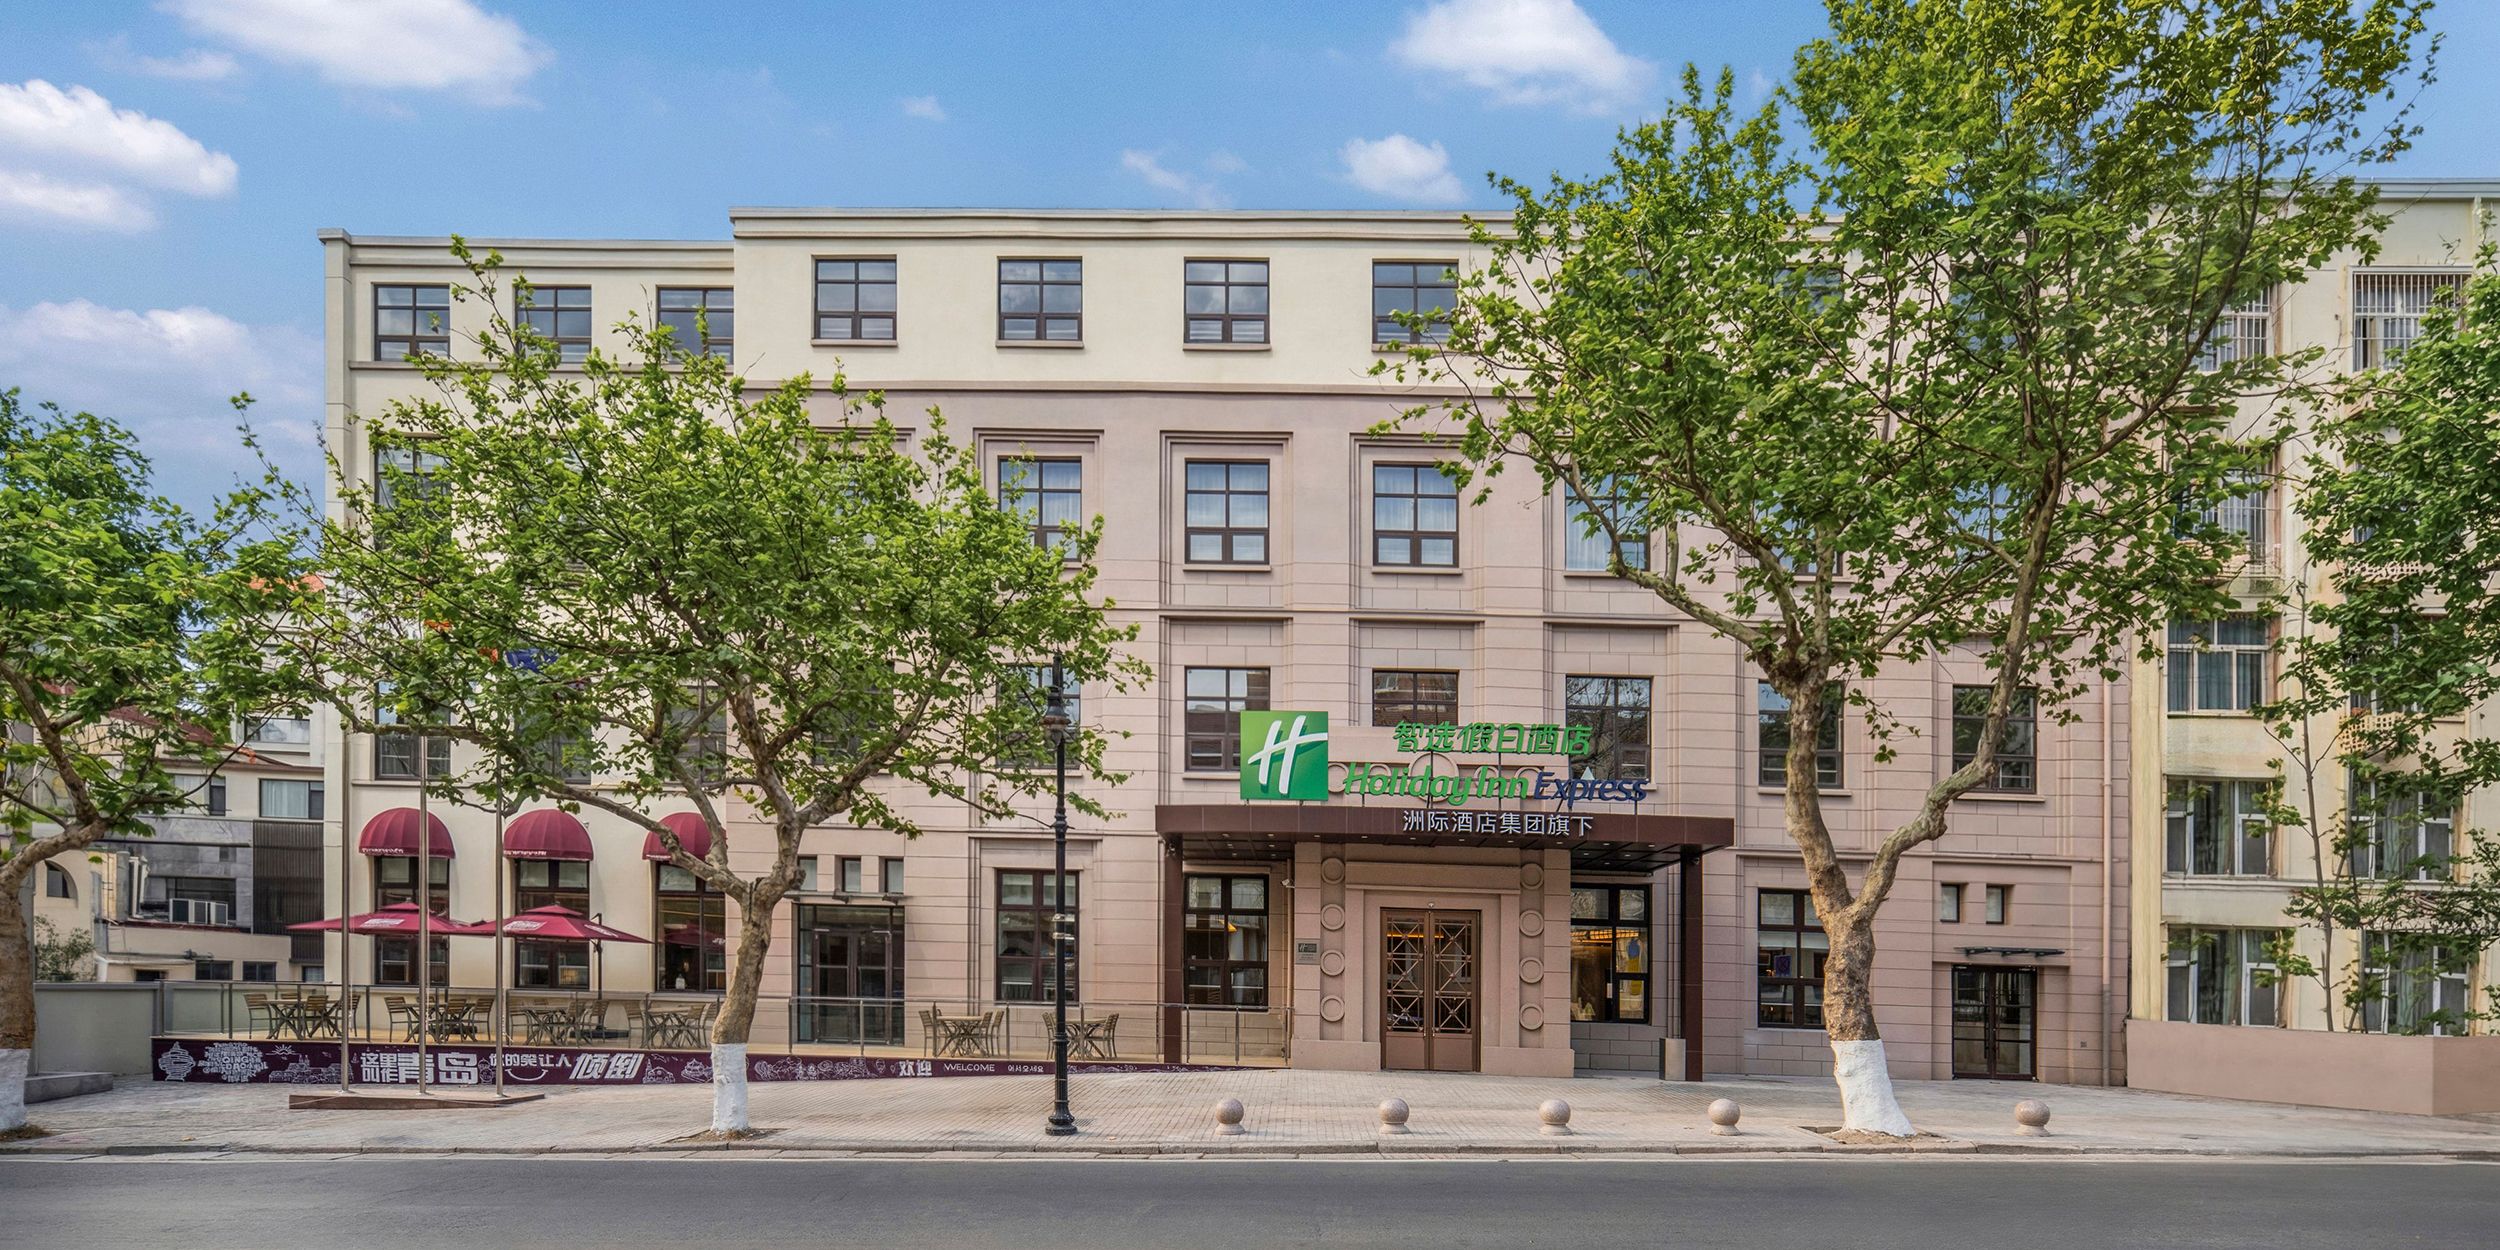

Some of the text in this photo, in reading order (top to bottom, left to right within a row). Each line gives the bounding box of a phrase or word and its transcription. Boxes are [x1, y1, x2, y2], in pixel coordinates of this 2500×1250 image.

[1393, 720, 1593, 756] 智选假日酒店
[1343, 762, 1649, 808] Holiday Inn Express
[1402, 810, 1594, 837] 洲际酒店集团旗下
[361, 1052, 398, 1067] 这里
[398, 1052, 478, 1084] 青岛
[569, 1053, 645, 1080] 倾倒
[898, 1060, 933, 1077] 欢迎
[943, 1063, 996, 1073] WELCOME
[1007, 1064, 1044, 1074] 어서오세요
